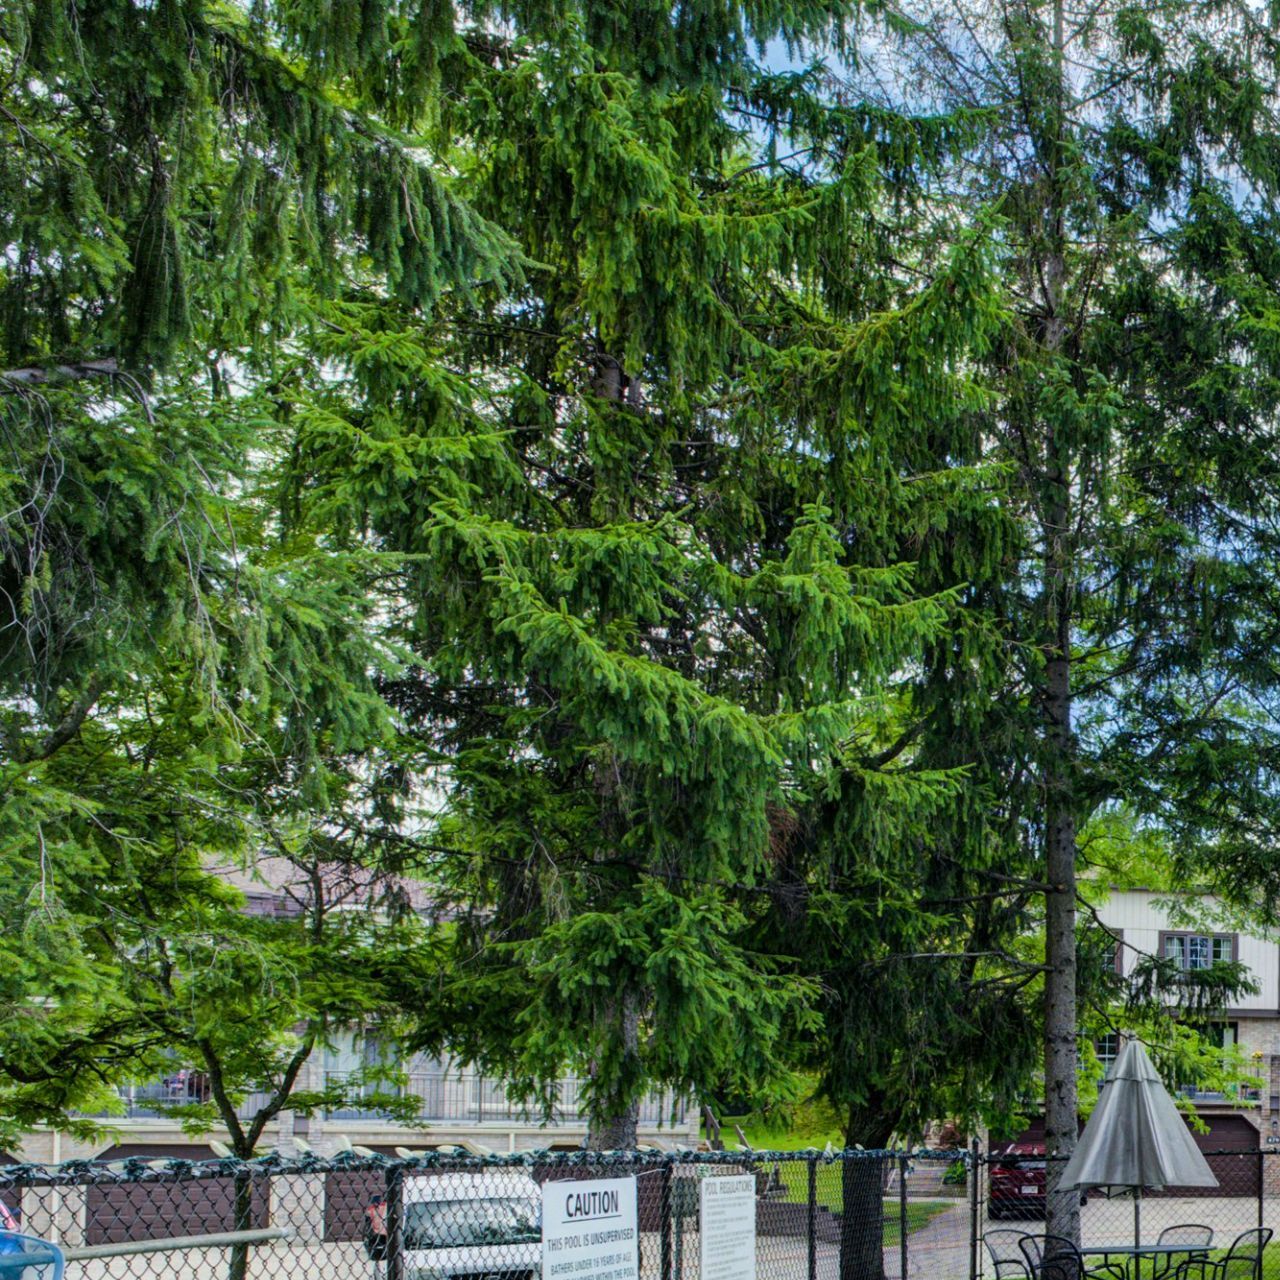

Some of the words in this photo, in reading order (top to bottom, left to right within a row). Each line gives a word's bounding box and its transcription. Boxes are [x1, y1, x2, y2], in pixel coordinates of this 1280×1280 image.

[705, 1182, 718, 1195] POOL
[719, 1179, 752, 1194] REGULATIONS
[566, 1190, 619, 1217] CAUTION
[547, 1237, 563, 1252] THIS
[564, 1234, 582, 1249] POOL
[583, 1233, 590, 1246] IS
[590, 1228, 634, 1245] UNSUPERVISED
[550, 1262, 573, 1276] BATHERS
[575, 1258, 592, 1271] UNDER
[600, 1254, 615, 1266] YEARS
[616, 1253, 622, 1263] OF
[613, 1269, 623, 1279] THE
[623, 1267, 635, 1277] POOL
